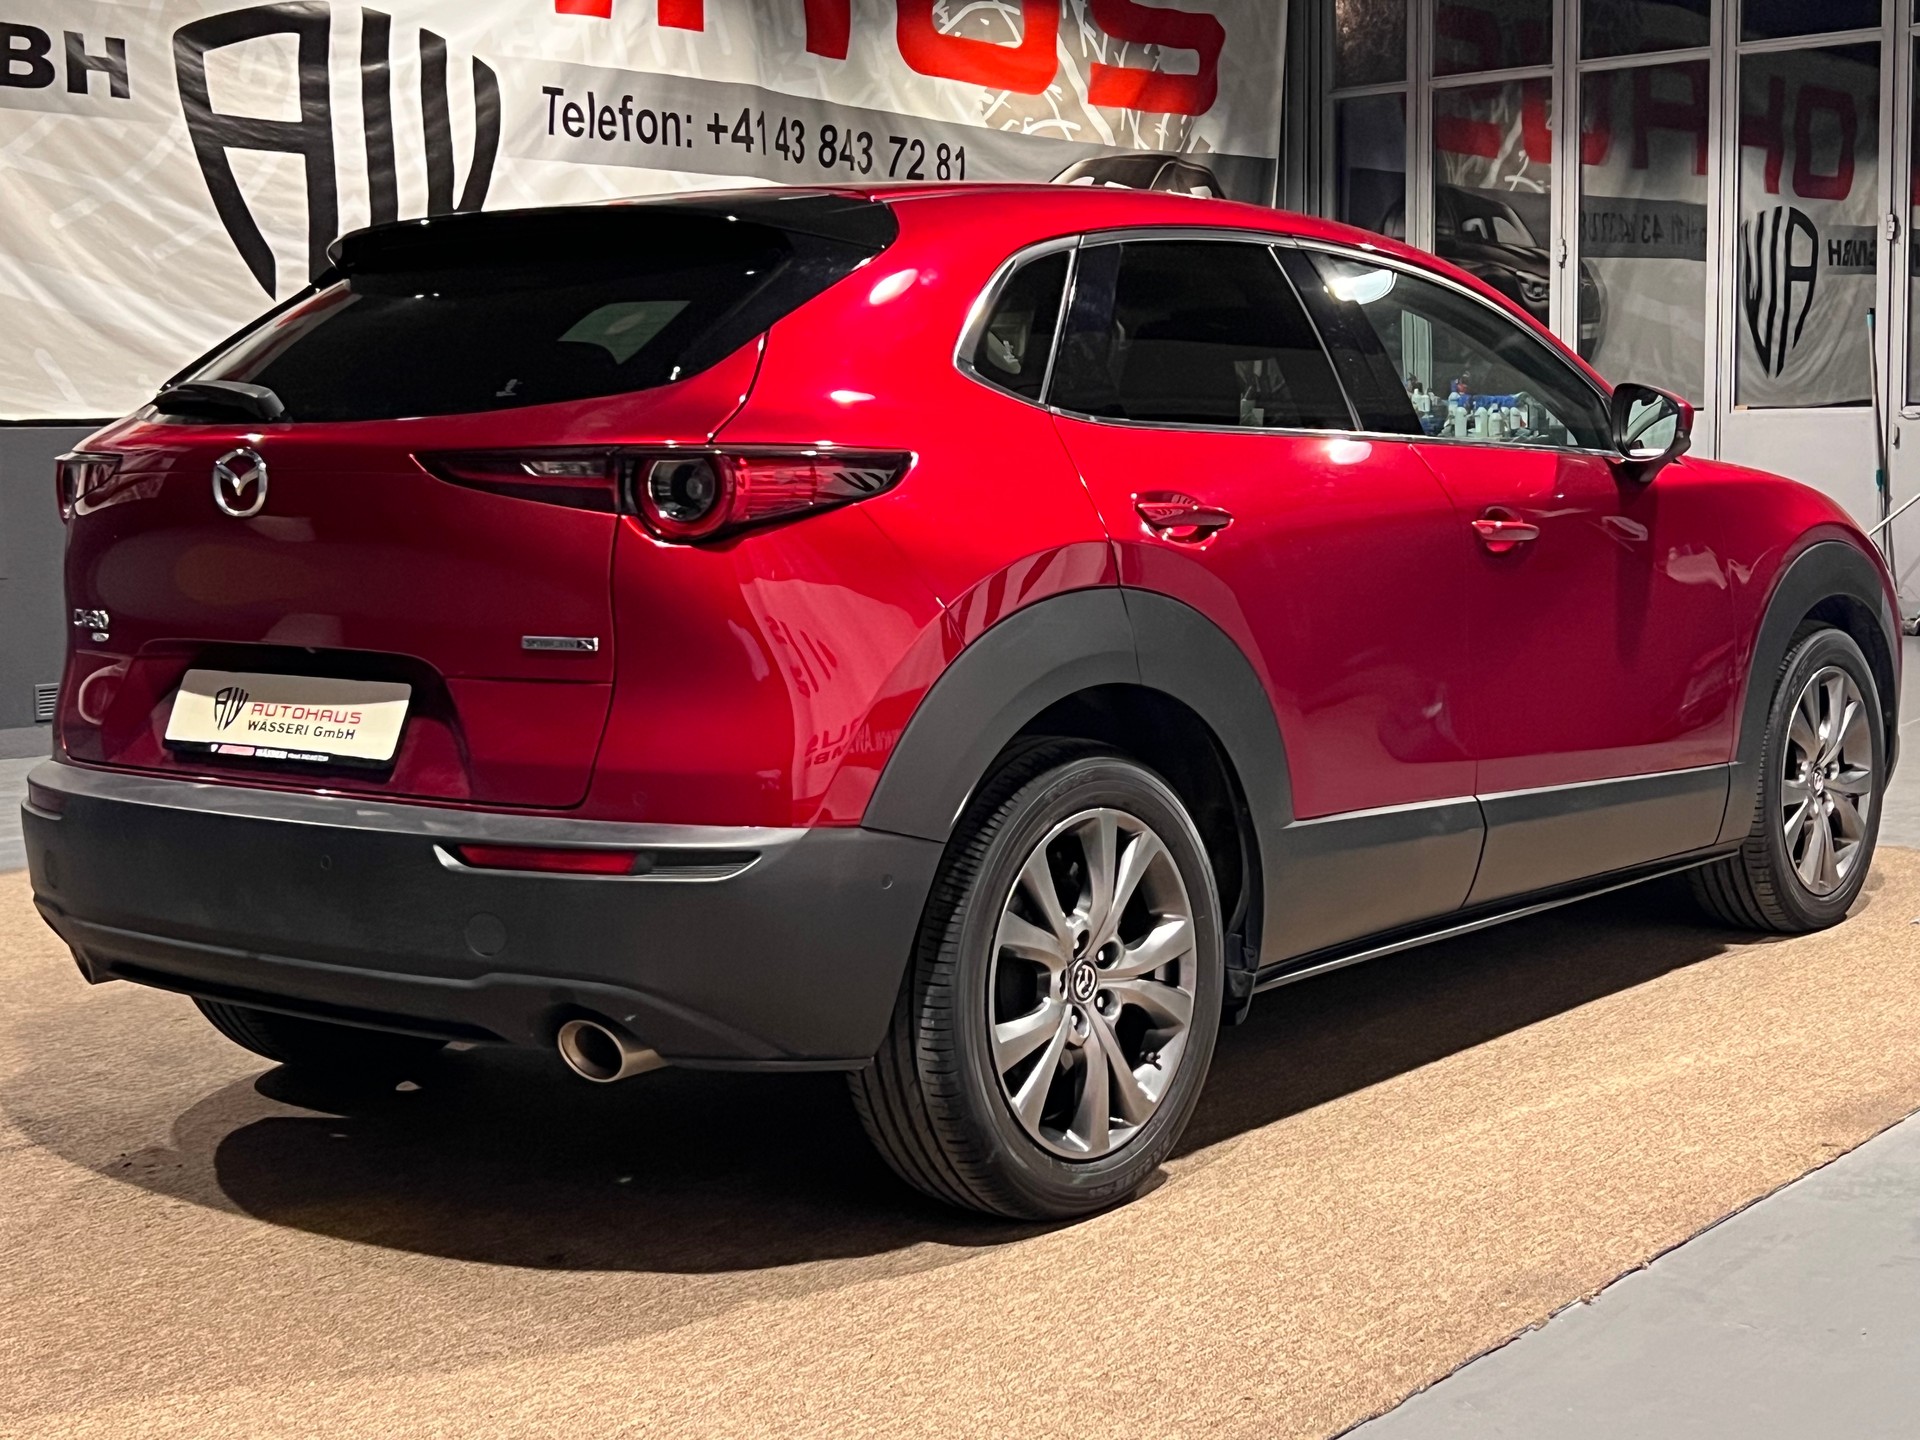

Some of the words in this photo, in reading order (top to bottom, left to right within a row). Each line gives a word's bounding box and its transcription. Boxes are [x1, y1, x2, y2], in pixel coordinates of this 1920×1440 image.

[542, 85, 692, 148] Telefon:
[775, 116, 805, 164] 43
[818, 124, 873, 175] 843
[888, 135, 925, 180] 72
[936, 142, 966, 181] 81
[250, 703, 363, 725] AUTOHAUS
[313, 726, 356, 740] GmbH
